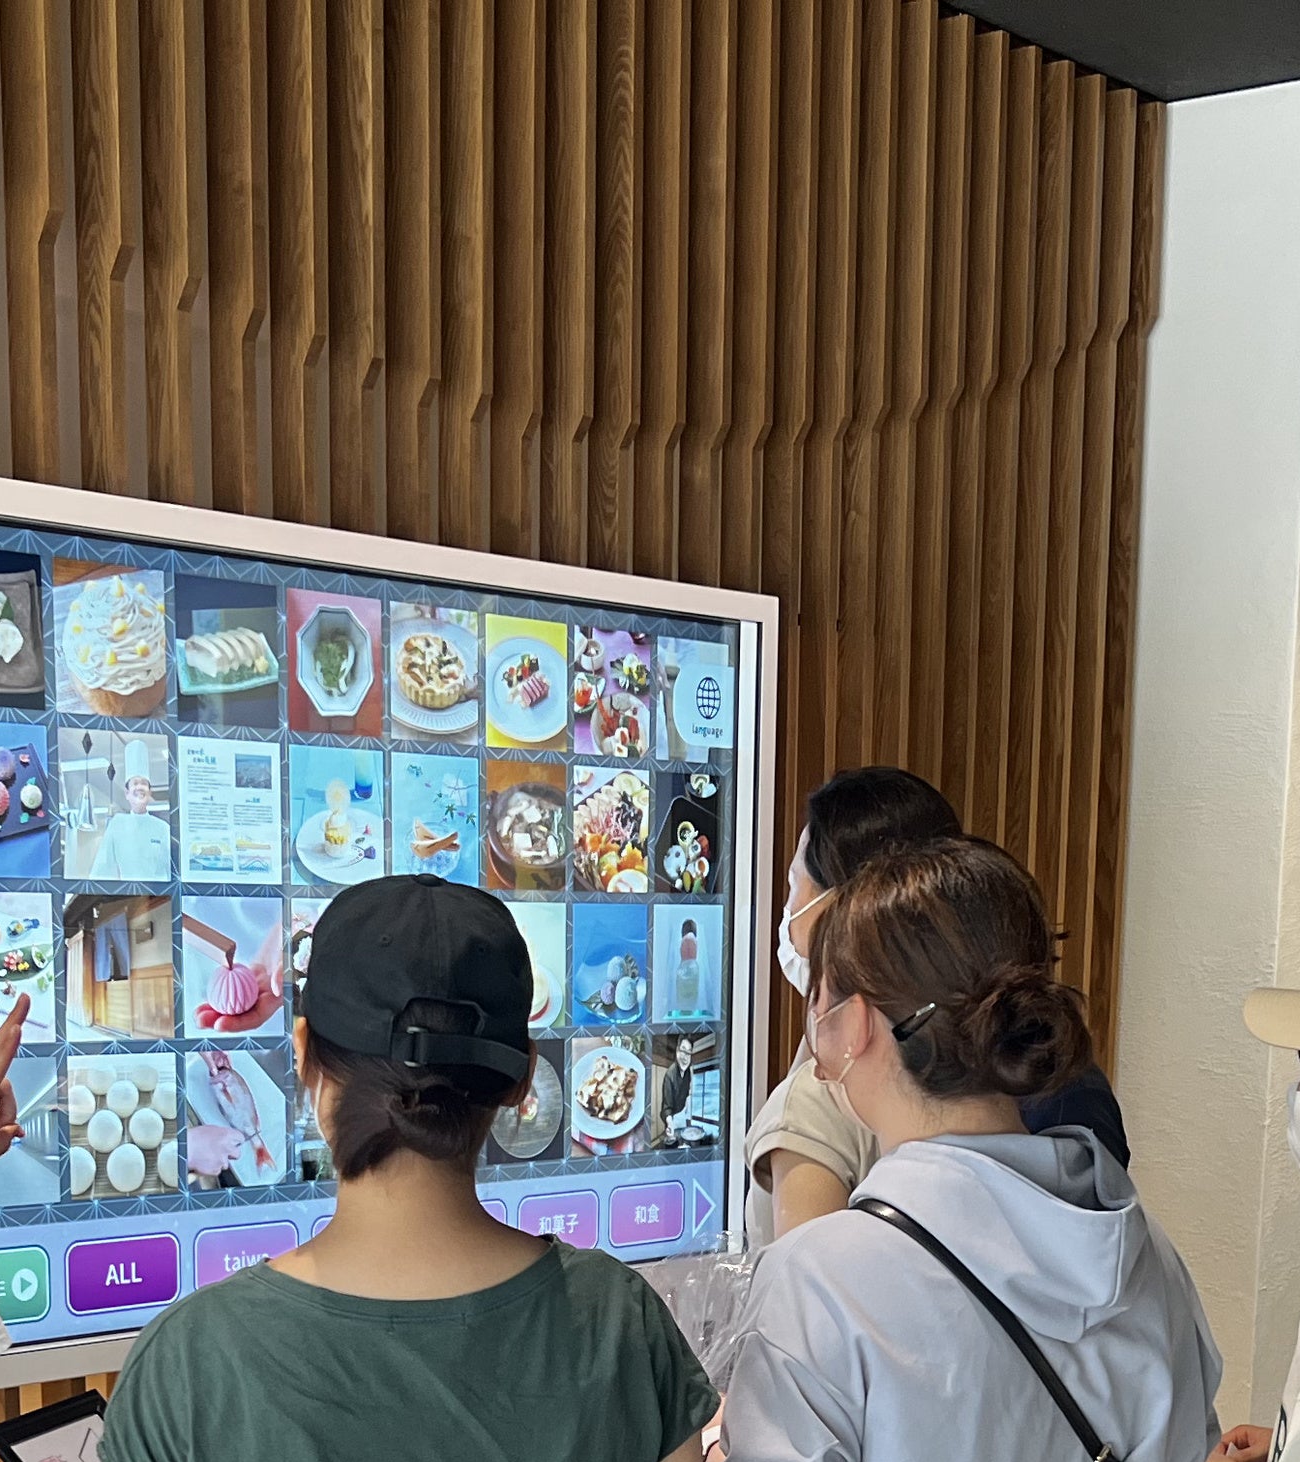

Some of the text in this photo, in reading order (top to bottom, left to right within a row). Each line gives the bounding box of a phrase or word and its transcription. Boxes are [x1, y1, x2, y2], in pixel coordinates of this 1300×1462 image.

[692, 724, 723, 739] language
[538, 1213, 579, 1235] 和菓子
[634, 1203, 660, 1225] 和食
[105, 1262, 143, 1286] ALL
